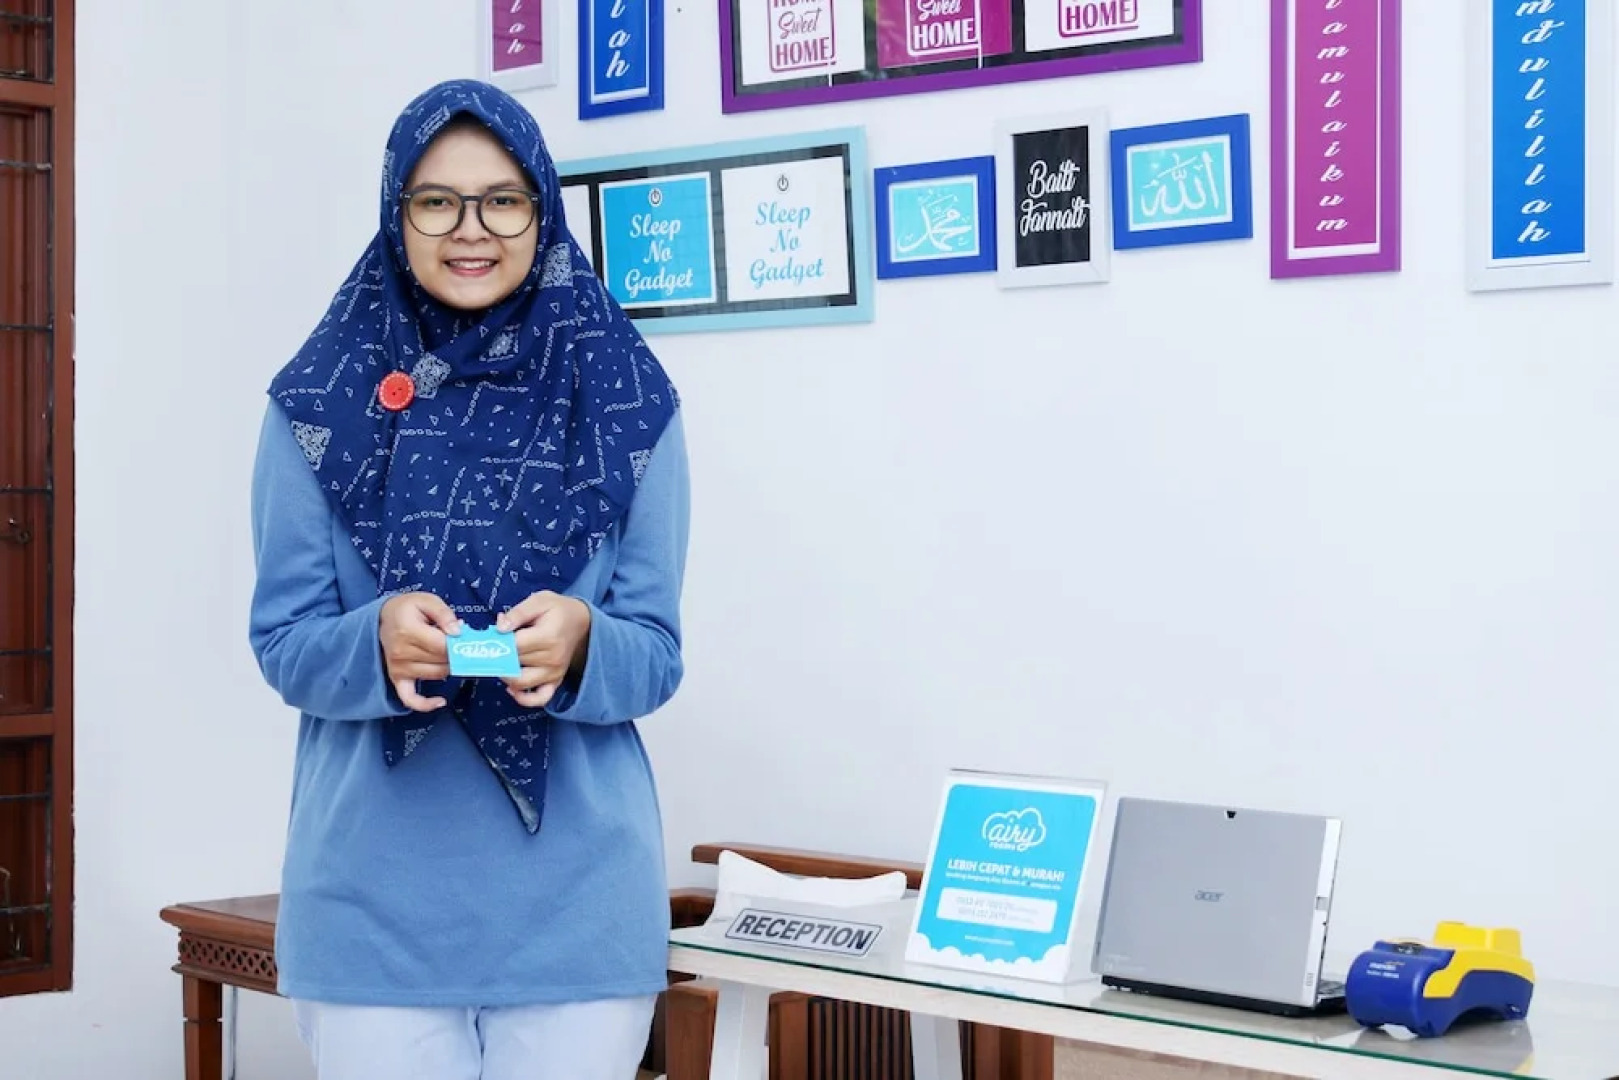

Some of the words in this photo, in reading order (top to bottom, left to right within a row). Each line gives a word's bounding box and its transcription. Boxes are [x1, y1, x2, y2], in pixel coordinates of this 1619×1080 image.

[778, 8, 823, 39] Sweet
[629, 213, 681, 241] Sleep
[755, 201, 811, 229] Sleep
[643, 240, 673, 264] No
[769, 229, 800, 253] No
[624, 268, 694, 298] Gadget
[749, 257, 825, 289] Gadget
[988, 817, 1037, 851] airy
[947, 858, 978, 872] LEBIH
[979, 862, 1012, 876] CEPAT
[1021, 867, 1065, 882] MURAH!
[1194, 890, 1225, 902] acer
[735, 914, 873, 950] RECEPTION
